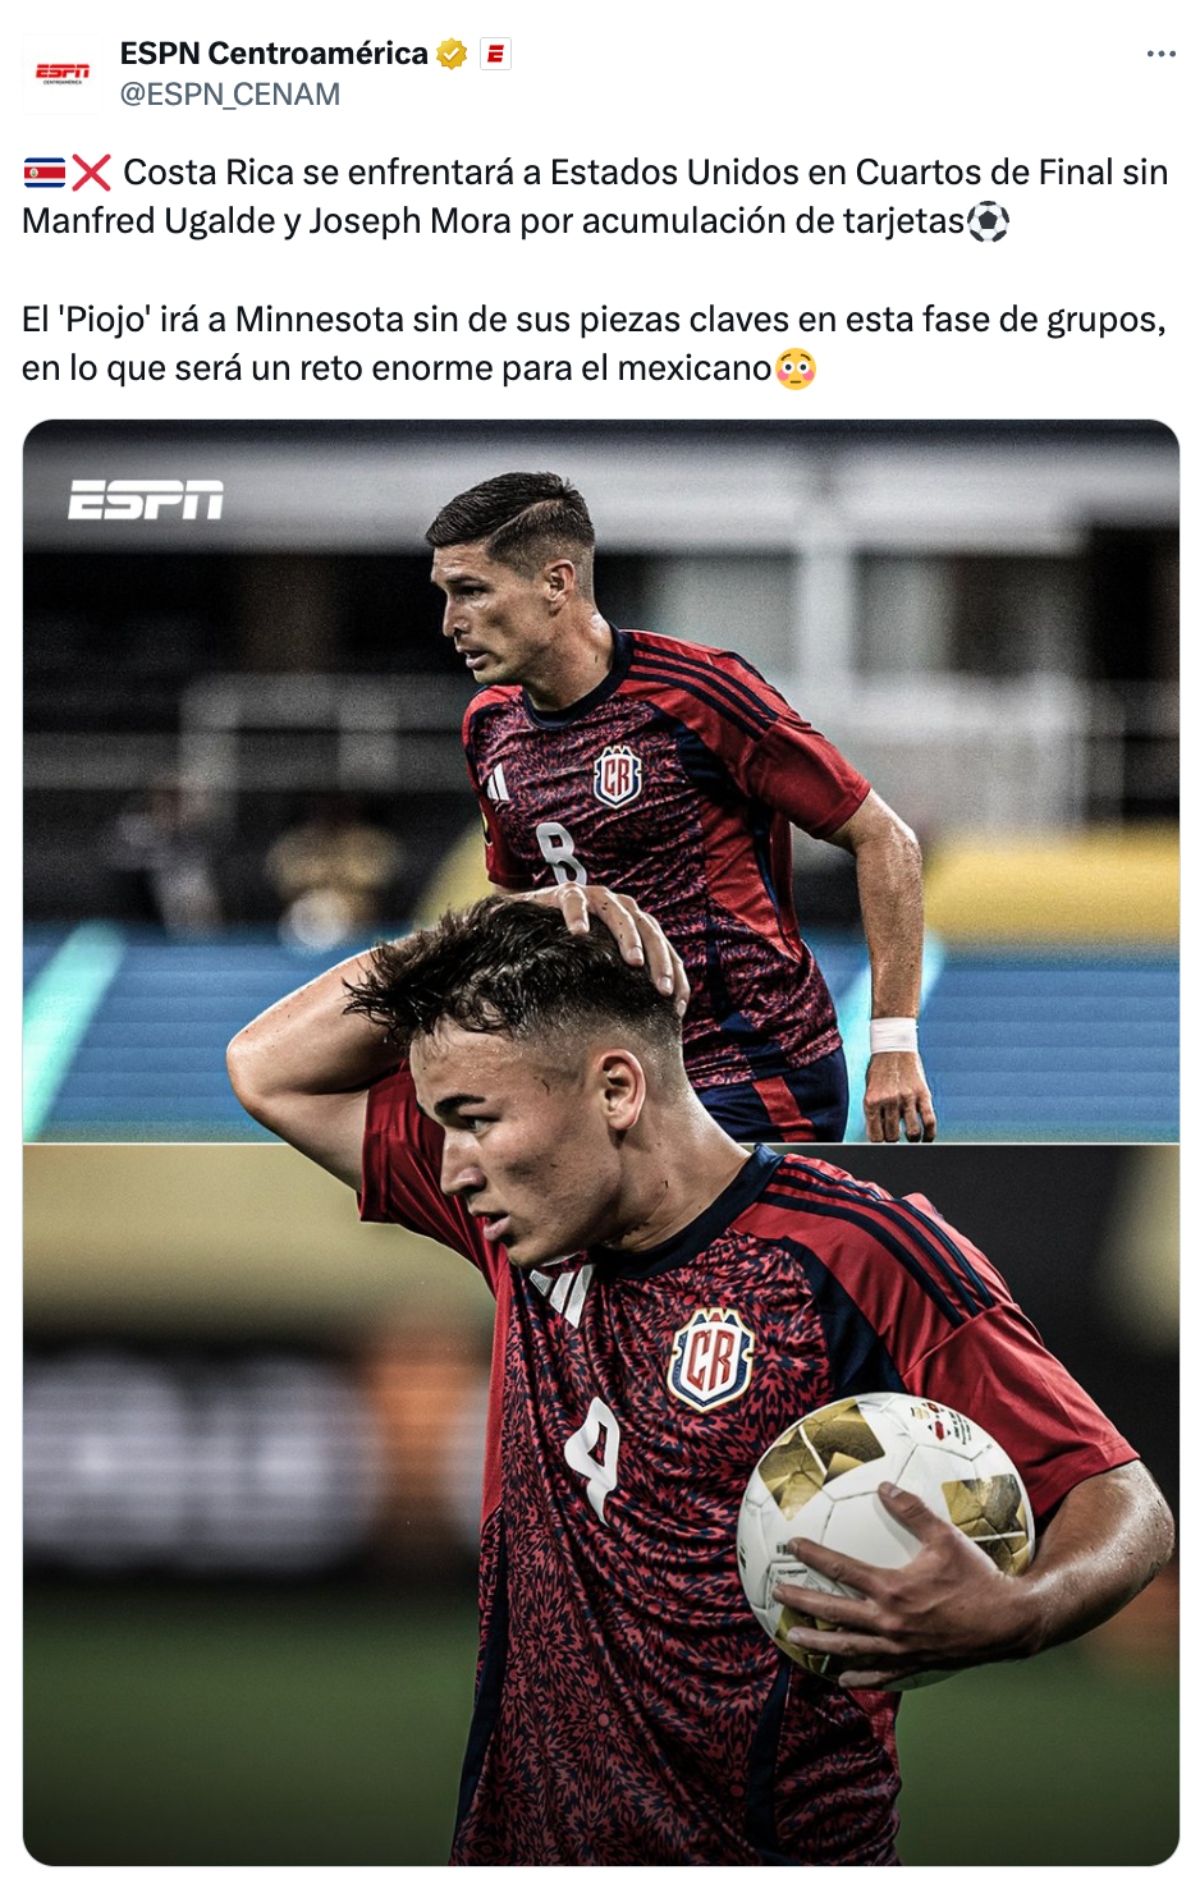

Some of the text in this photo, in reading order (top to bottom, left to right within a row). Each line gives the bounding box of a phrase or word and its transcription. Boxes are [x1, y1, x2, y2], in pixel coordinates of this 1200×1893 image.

[121, 40, 428, 65] ESPN Centroamérica
[36, 64, 90, 78] ESPN
[121, 82, 339, 110] @ESPN_CENAM
[124, 157, 1167, 185] Costa Rica se enfrentará a Estados Unidos en Cuartos de Final sin
[24, 206, 964, 240] Manfred Ugalde y Joseph Mora por acumulación de tarjetas
[24, 304, 1165, 339] El 'Piojo' irá a Minnesota sin de sus piezas claves en esta fase de grupos,
[23, 353, 772, 387] en lo que será un reto enorme para el mexicano
[604, 758, 630, 795] CR
[535, 822, 587, 886] 8
[687, 1329, 735, 1391] CR
[564, 1396, 620, 1527] 9
